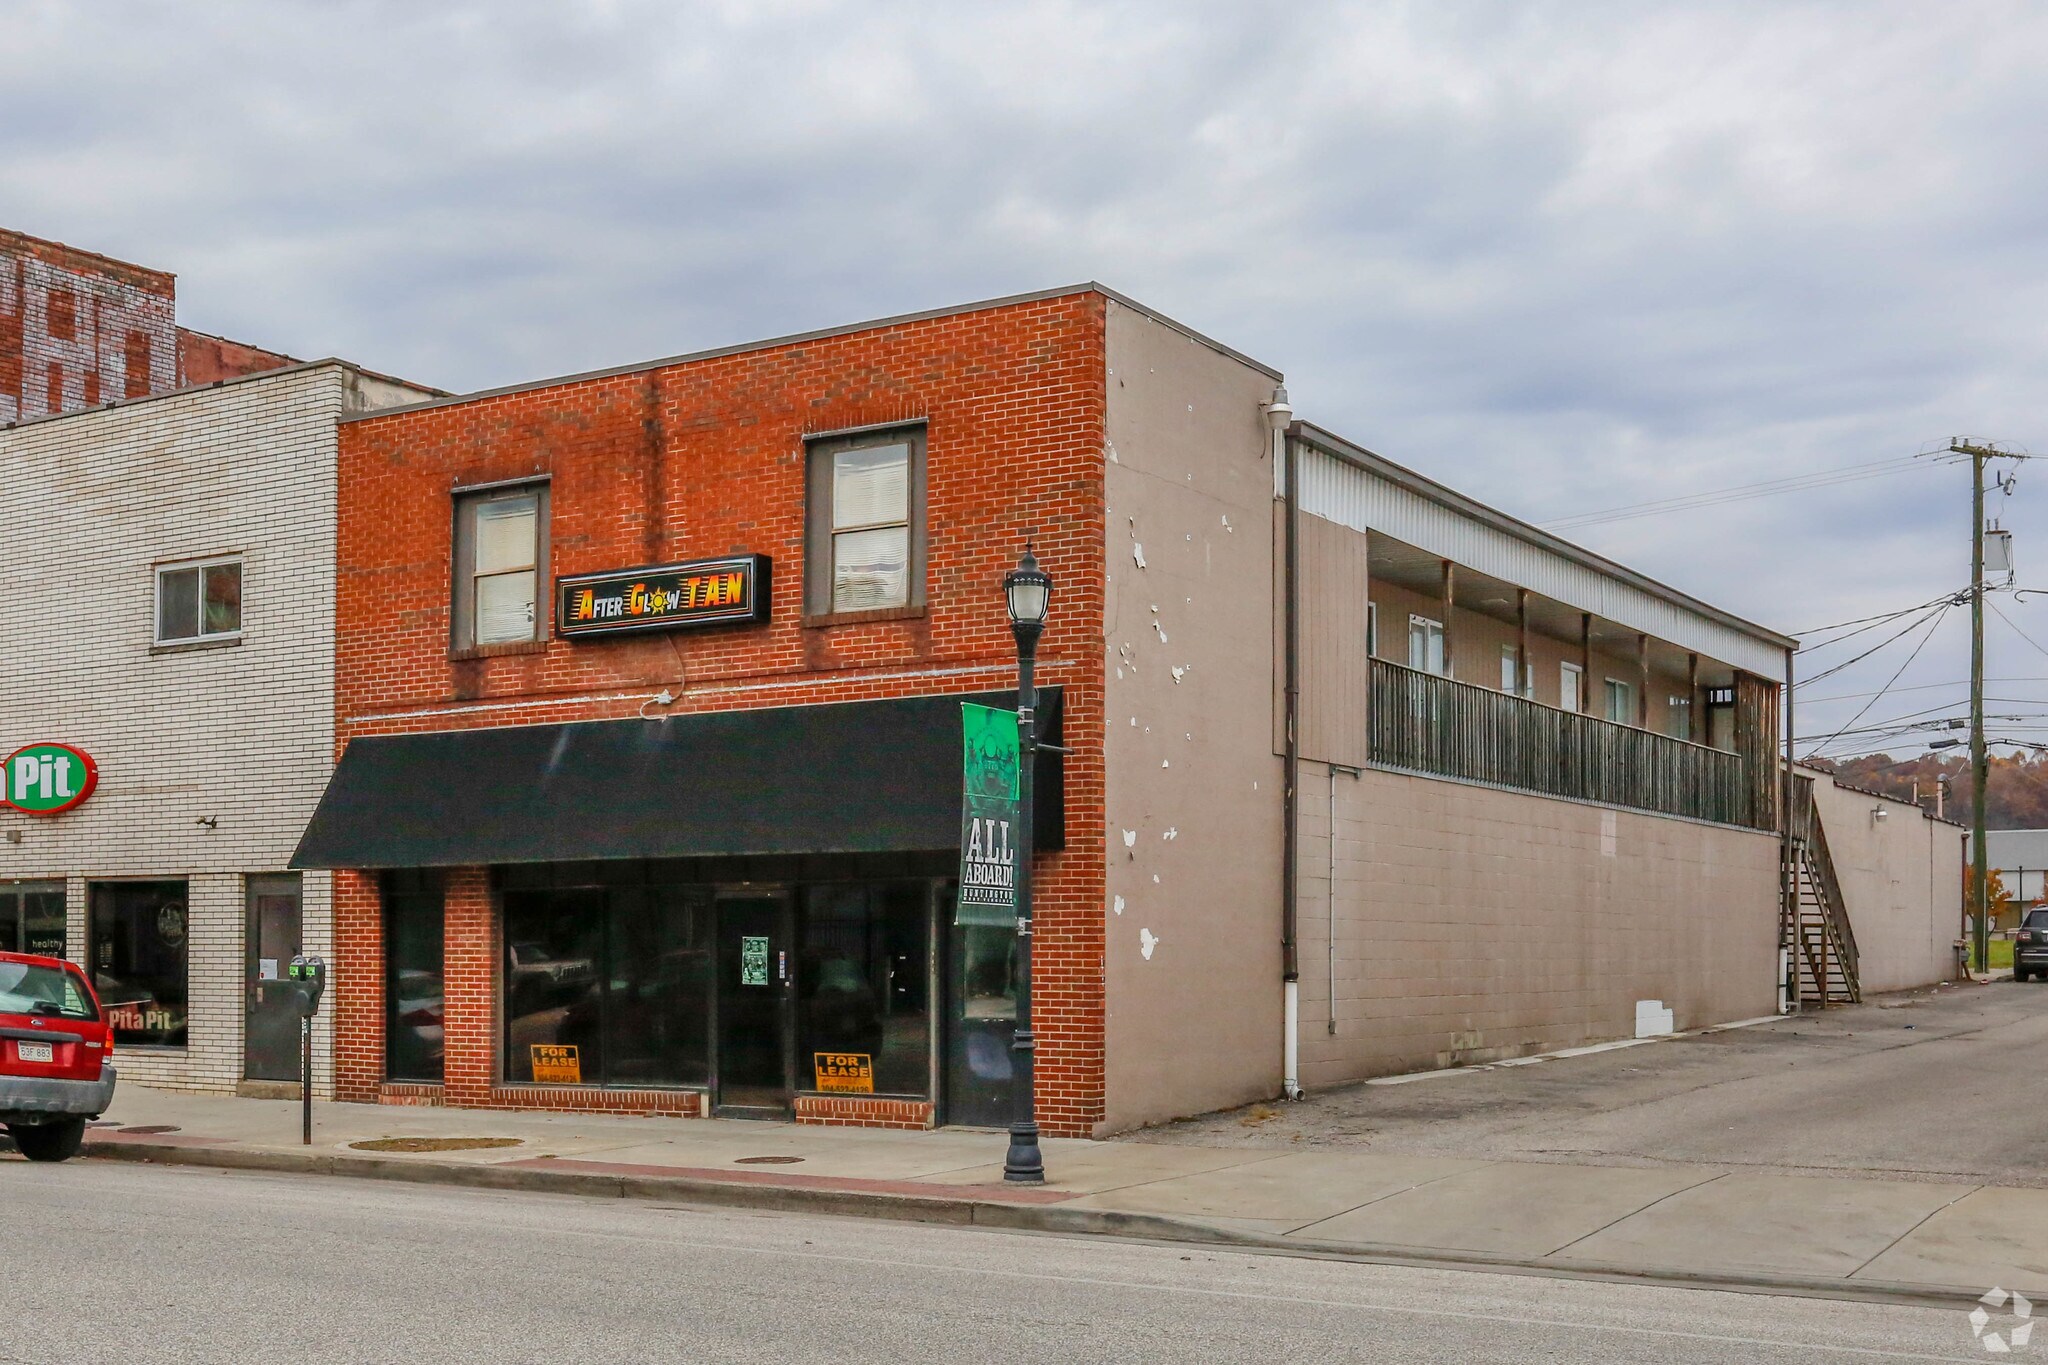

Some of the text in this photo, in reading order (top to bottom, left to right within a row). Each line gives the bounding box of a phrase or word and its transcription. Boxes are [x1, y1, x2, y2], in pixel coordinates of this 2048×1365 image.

[577, 589, 623, 620] AFTER
[686, 572, 743, 608] TAN
[14, 754, 71, 800] Pit
[965, 818, 1013, 864] ALL
[964, 863, 1013, 887] ABOARD!
[963, 888, 1014, 900] HUNTINGTON
[32, 938, 64, 951] healthy
[109, 1010, 171, 1030] Pita Pit
[36, 1047, 51, 1058] 883
[541, 1047, 568, 1056] FOR
[534, 1058, 576, 1066] LEASE
[827, 1056, 858, 1066] FOR
[818, 1066, 869, 1077] LEASE
